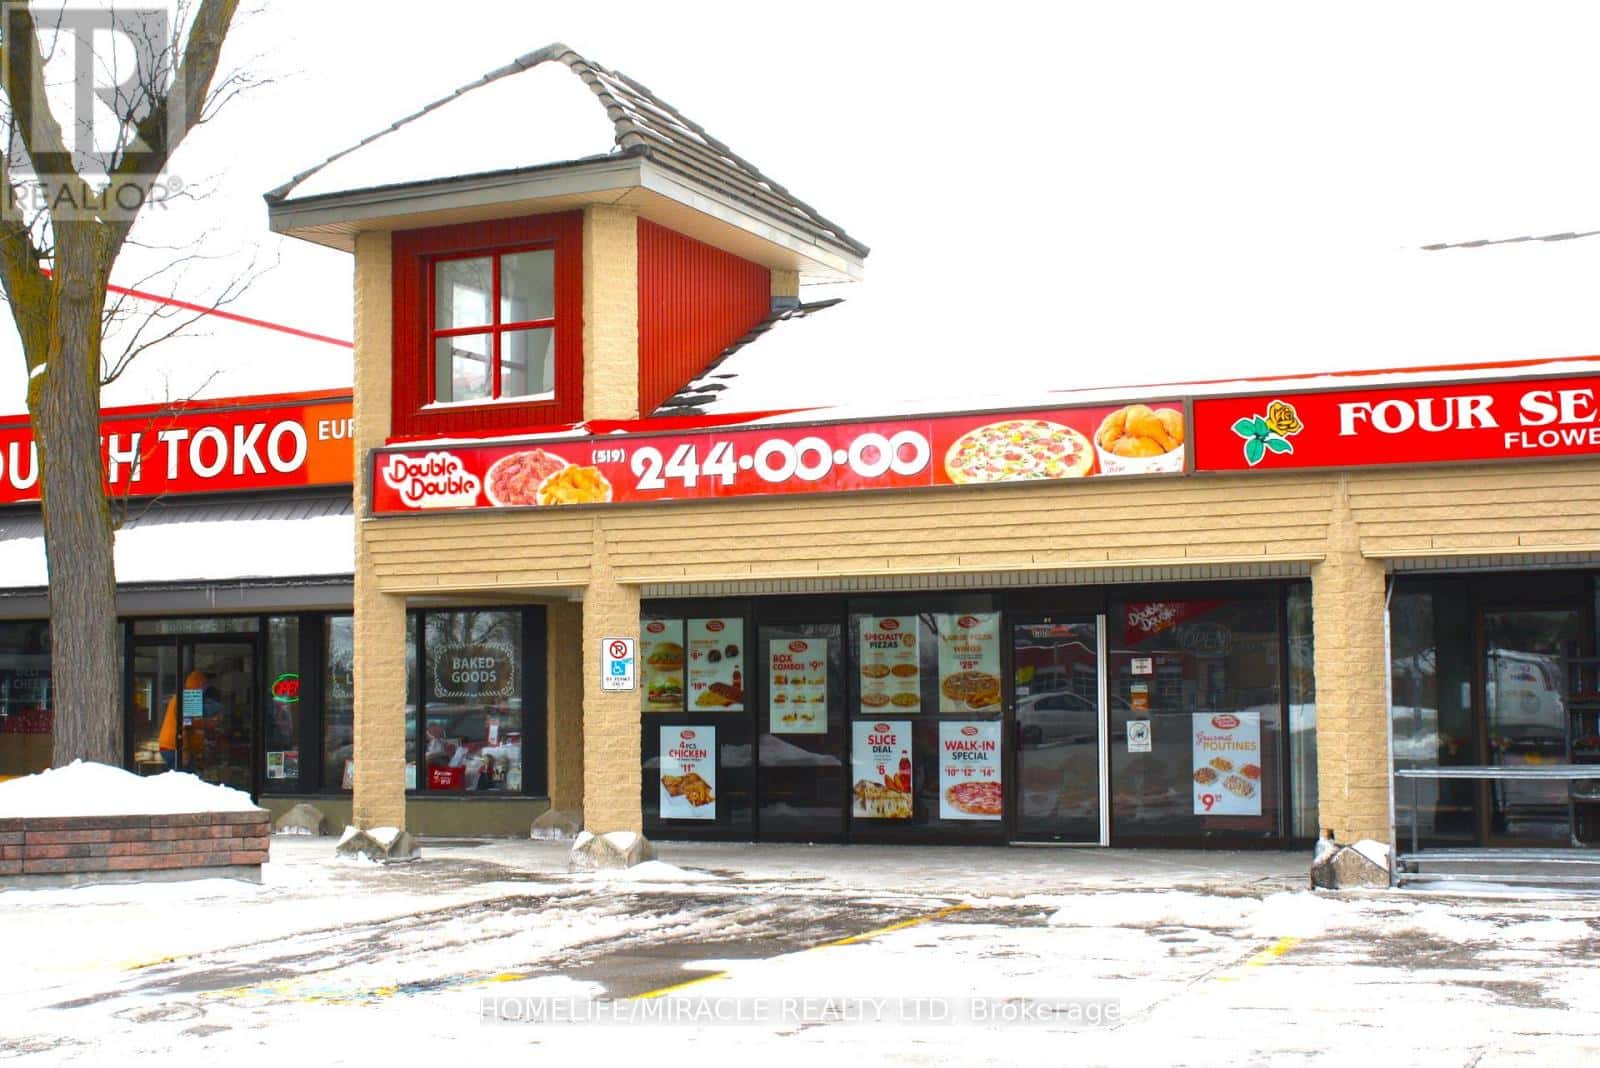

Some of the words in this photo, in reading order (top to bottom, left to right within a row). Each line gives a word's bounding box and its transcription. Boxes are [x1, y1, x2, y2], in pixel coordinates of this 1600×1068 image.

[1338, 395, 1499, 436] FOUR
[1519, 388, 1600, 426] SE
[158, 420, 308, 480] TOKO
[591, 447, 626, 465] (519)
[389, 458, 458, 484] Double
[406, 475, 475, 501] Double
[869, 640, 898, 648] PIZZAS
[452, 657, 495, 670] BAKED
[451, 670, 497, 683] GOODS
[680, 741, 685, 749] 4
[867, 735, 897, 745] SLICE
[945, 741, 995, 751] WALK-IN
[1203, 741, 1257, 752] POUTINES
[669, 749, 707, 758] CHICKEN
[952, 751, 988, 760] SPECIAL
